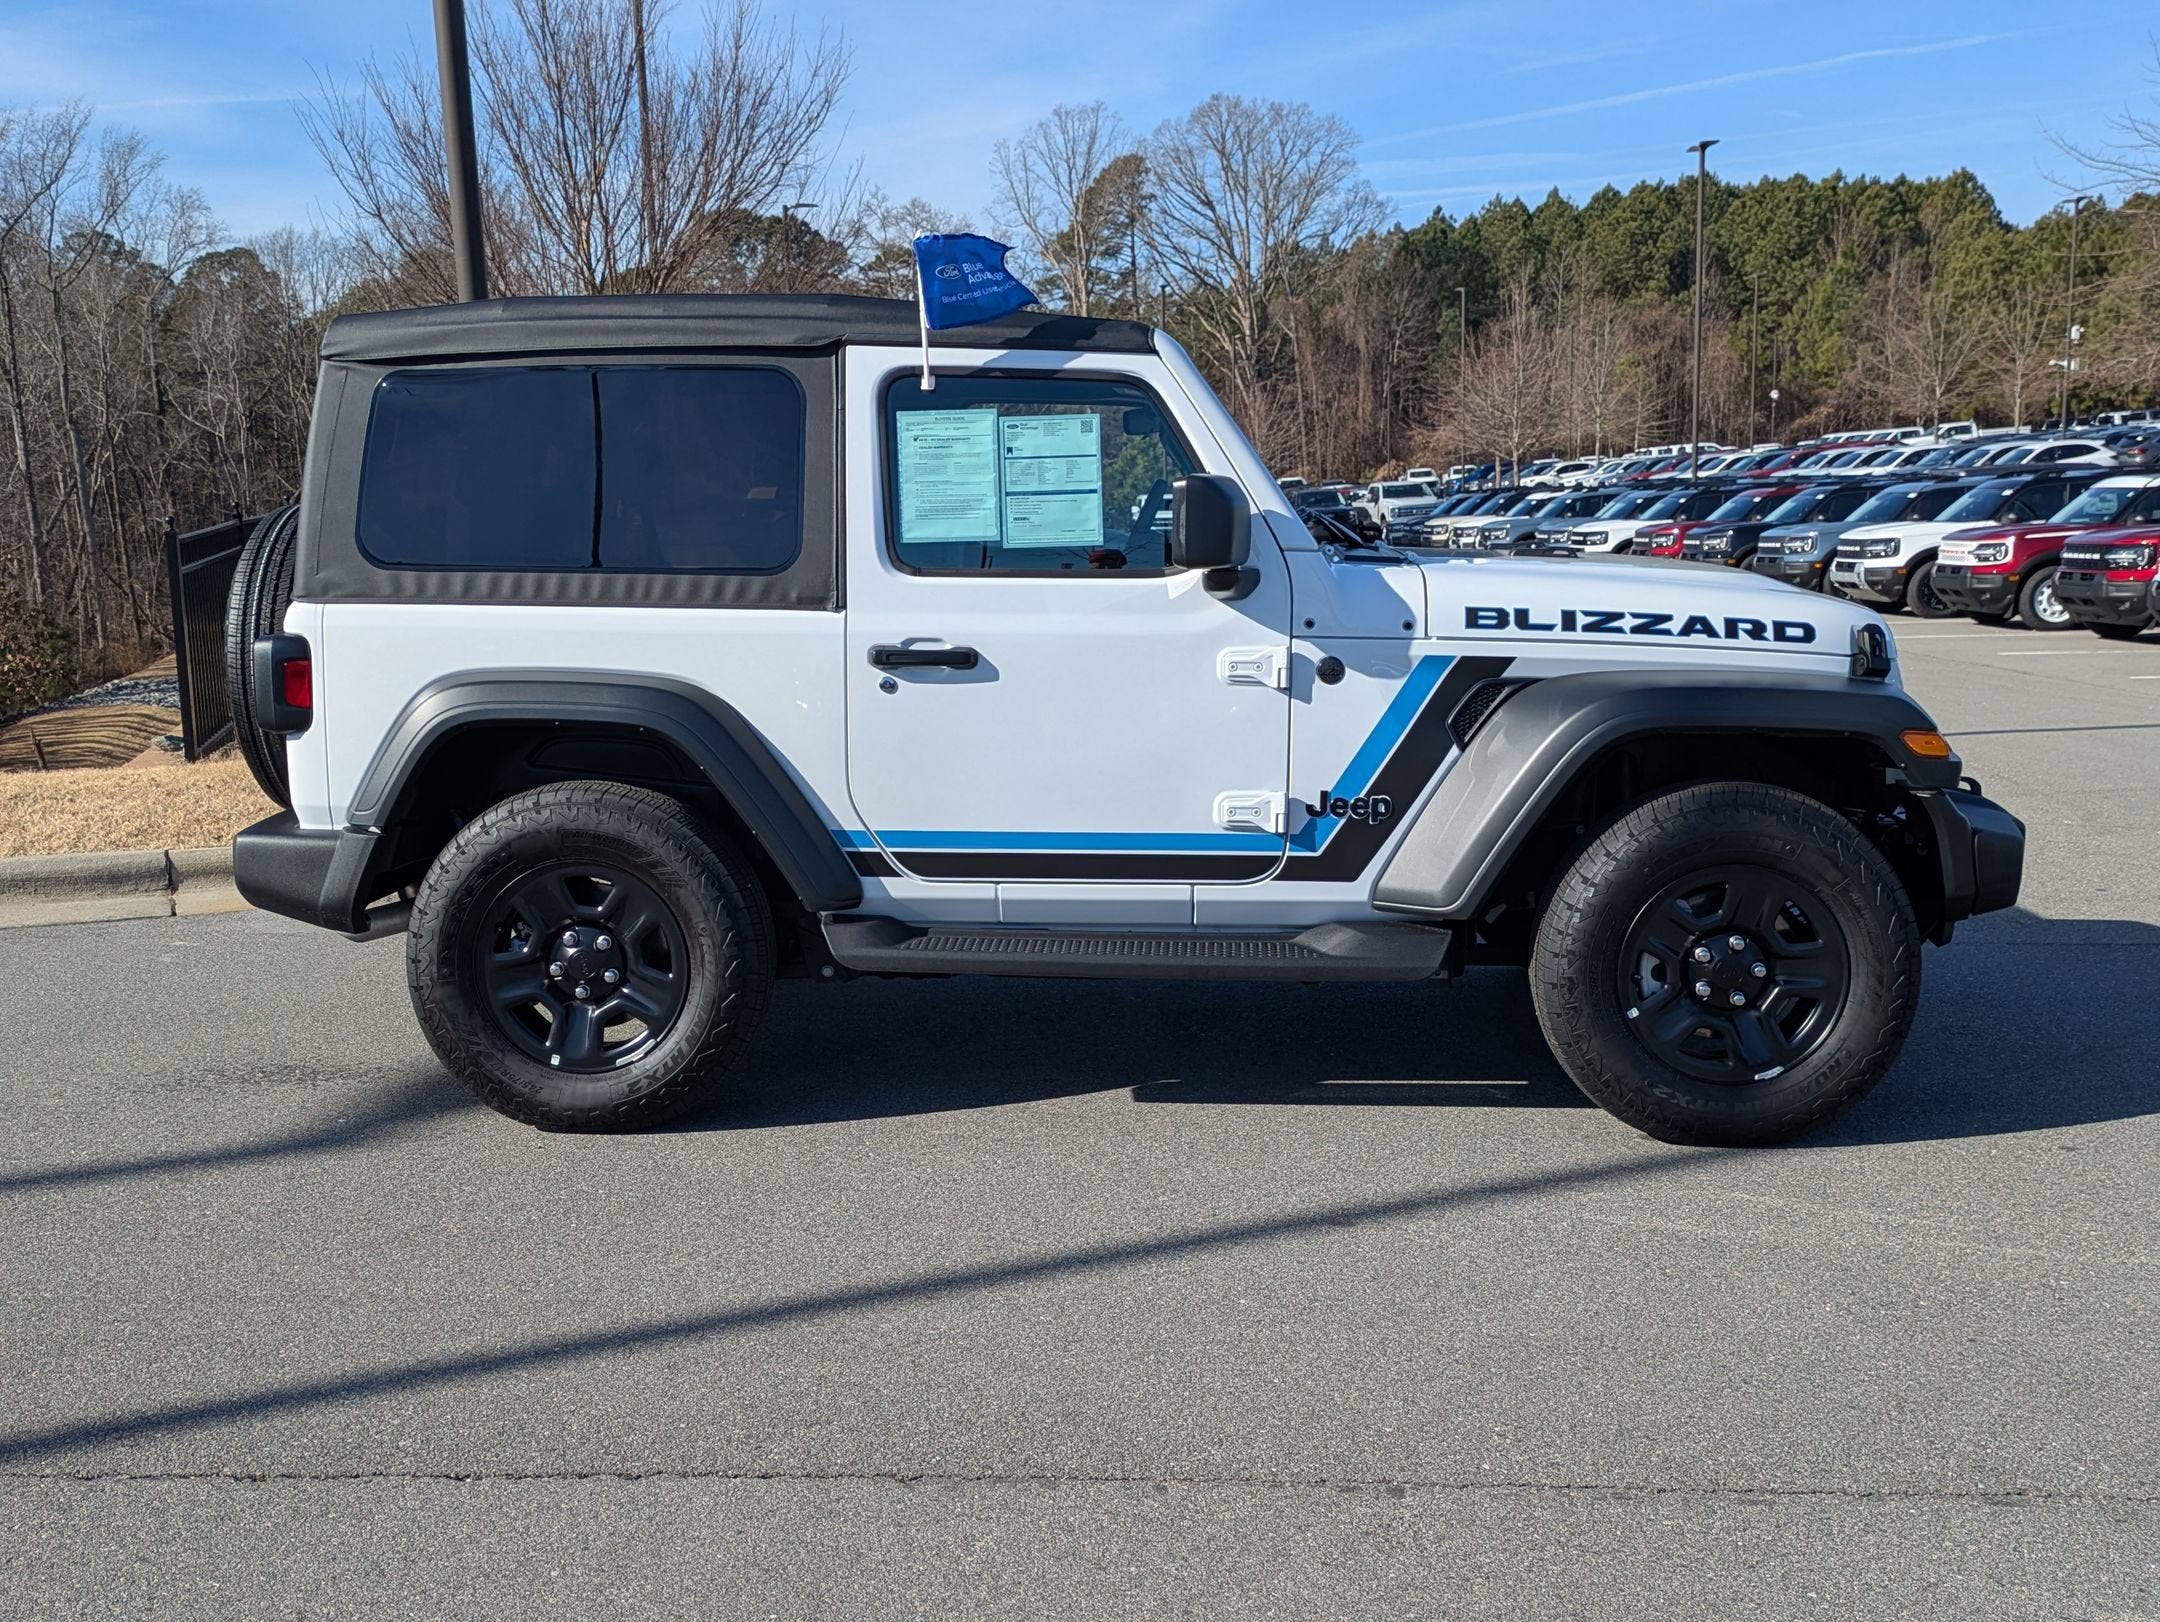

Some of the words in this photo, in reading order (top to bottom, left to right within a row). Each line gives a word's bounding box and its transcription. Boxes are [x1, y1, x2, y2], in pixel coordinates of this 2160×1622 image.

[943, 265, 960, 277] Ford
[962, 262, 984, 273] Blue
[941, 295, 957, 304] Blue
[1465, 605, 1816, 644] BLIZZARD
[1305, 790, 1393, 825] Jeep
